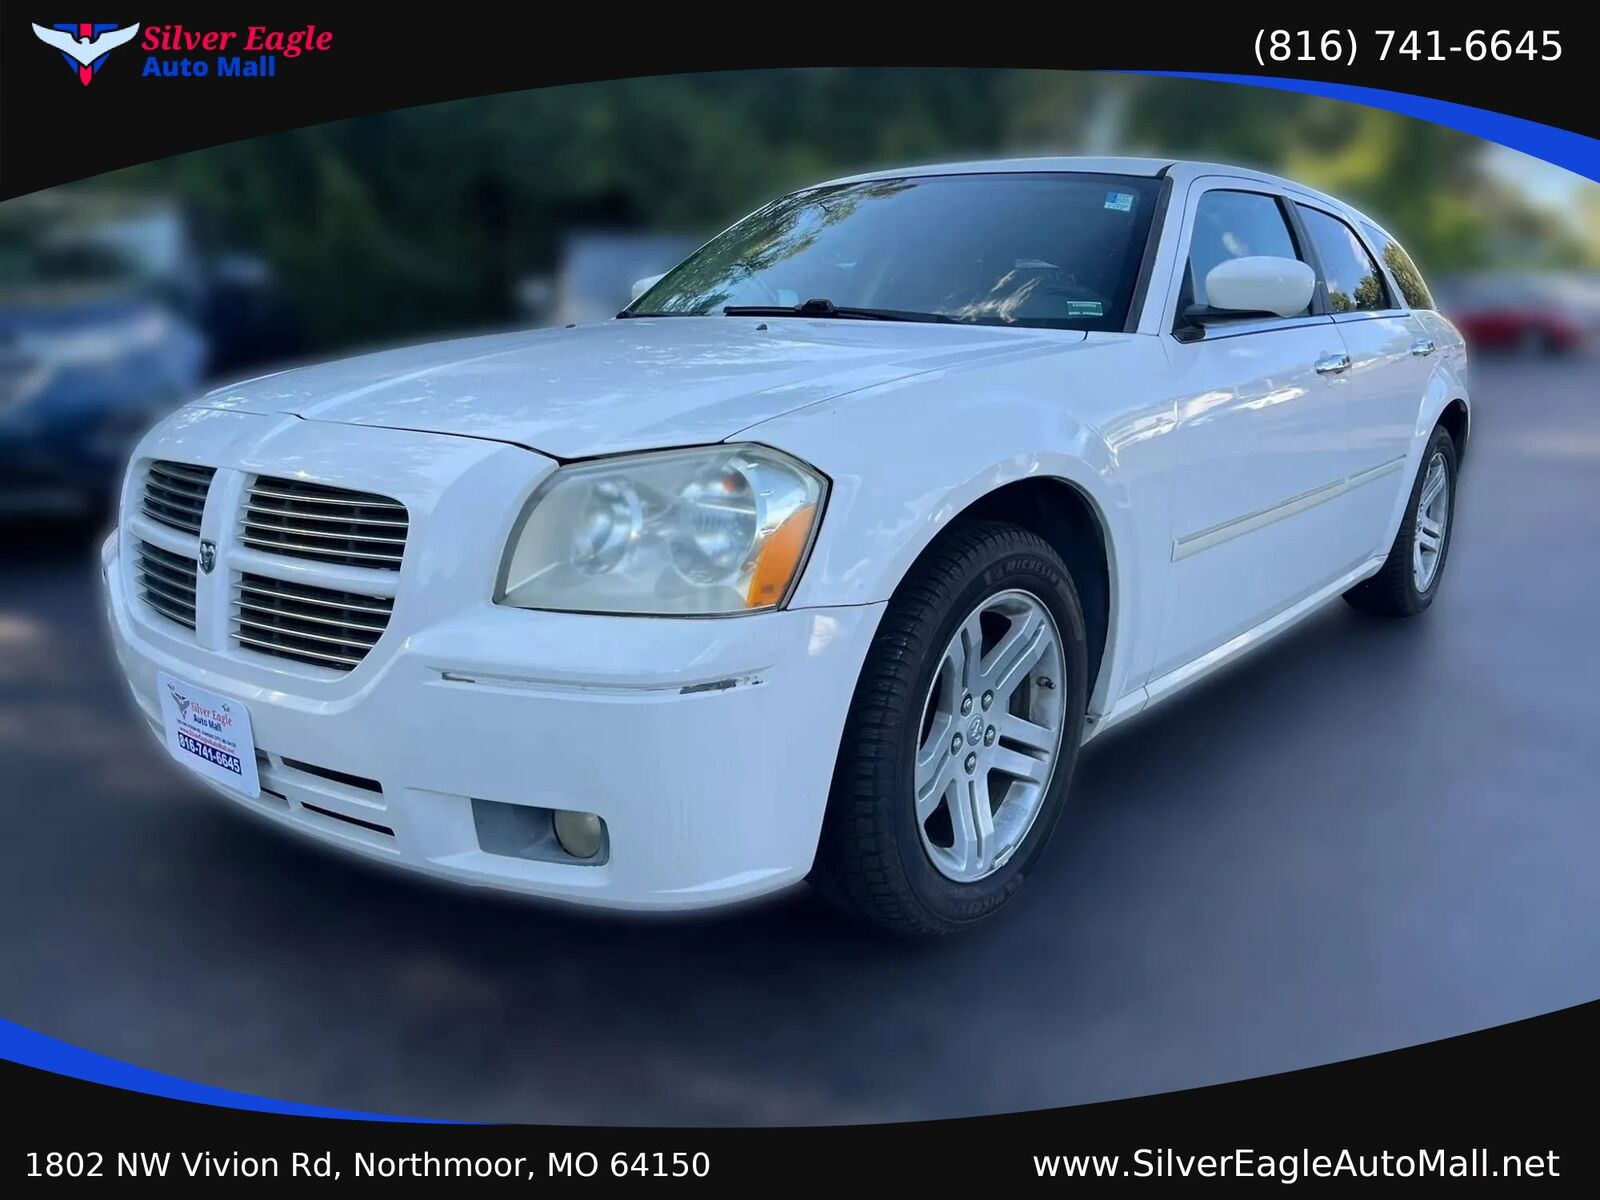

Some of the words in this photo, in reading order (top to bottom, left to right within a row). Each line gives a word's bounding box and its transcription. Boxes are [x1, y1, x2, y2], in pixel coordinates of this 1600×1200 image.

[1004, 558, 1059, 584] MICHELIN
[191, 702, 210, 717] Silver
[212, 710, 232, 727] Eagle
[194, 713, 207, 727] Auto
[179, 733, 240, 773] 816-741-6645
